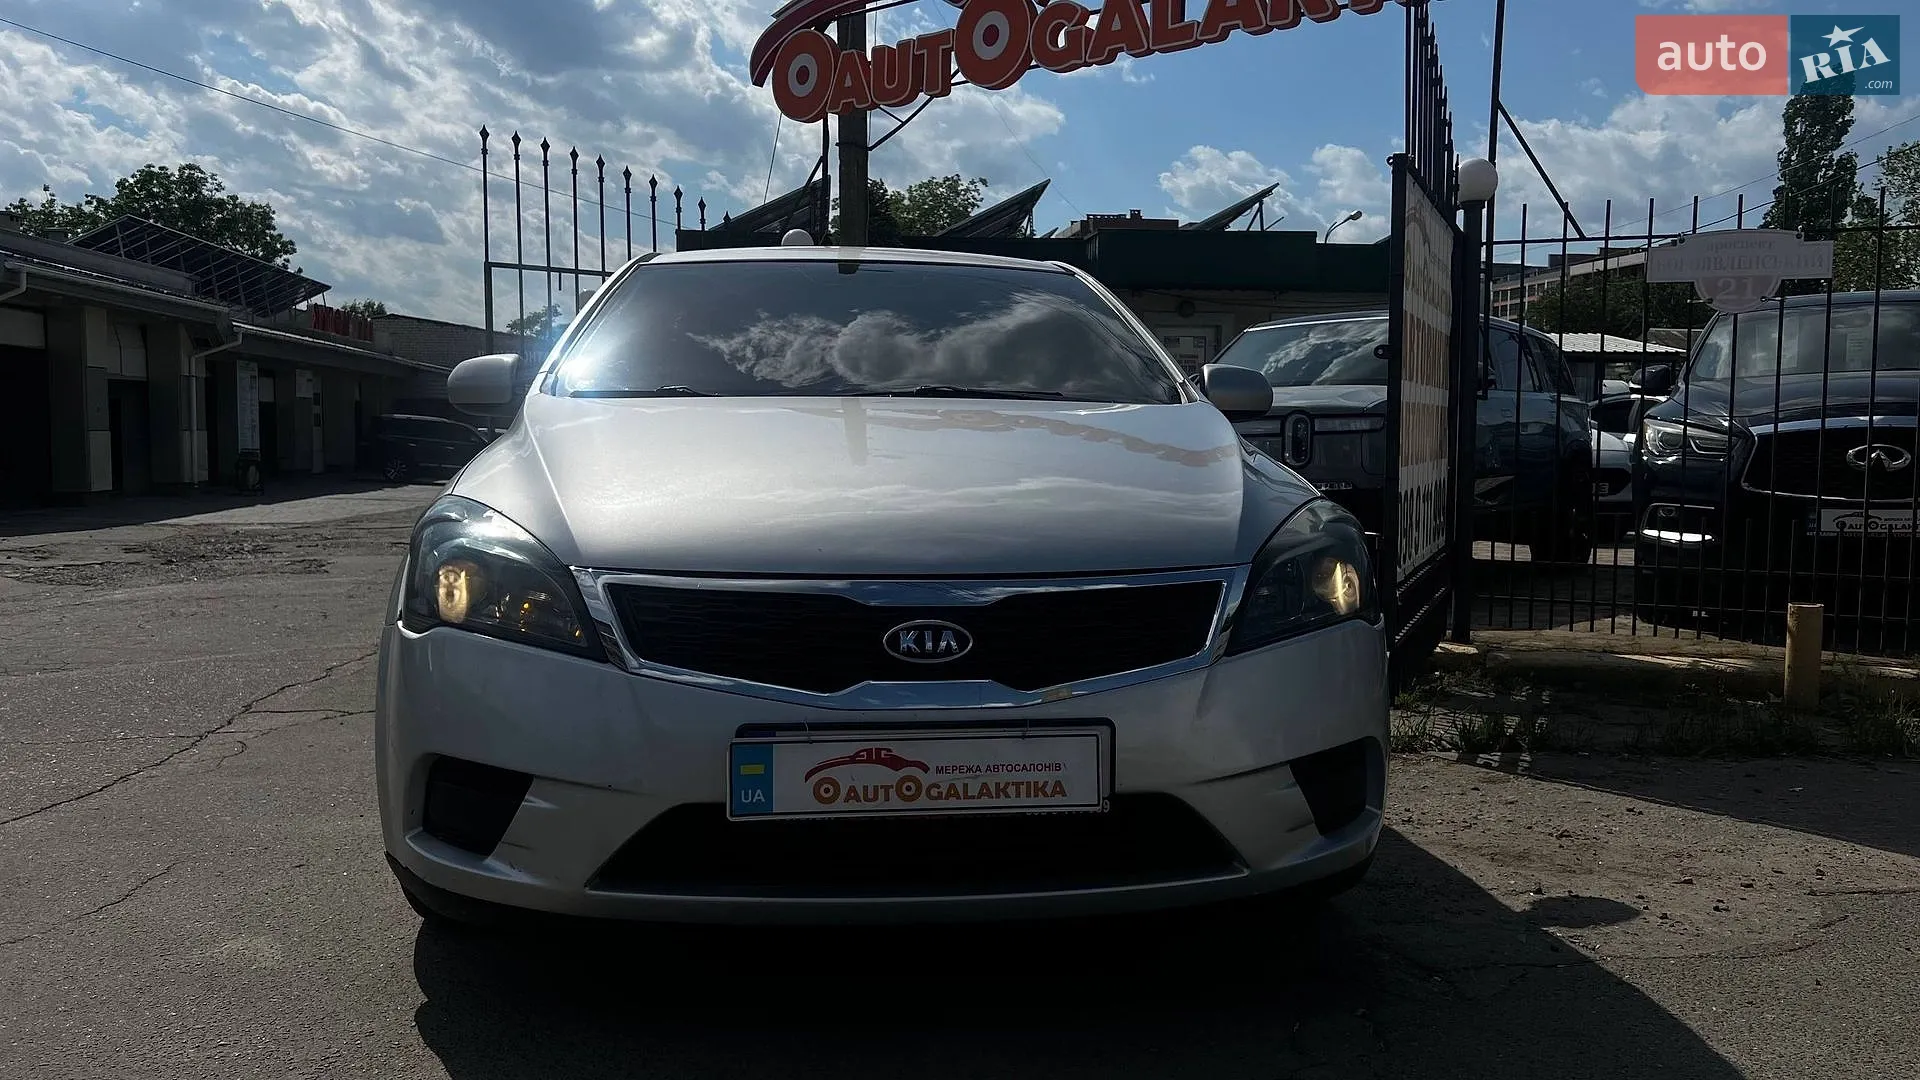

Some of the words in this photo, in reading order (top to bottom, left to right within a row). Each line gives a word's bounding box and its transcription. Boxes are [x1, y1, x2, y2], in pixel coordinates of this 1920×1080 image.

[1716, 278, 1758, 300] 21
[899, 630, 960, 653] KIA
[935, 764, 982, 775] МЕРЕЖА
[985, 762, 1062, 774] АВТОСАЛОНІВ
[741, 788, 766, 803] UA
